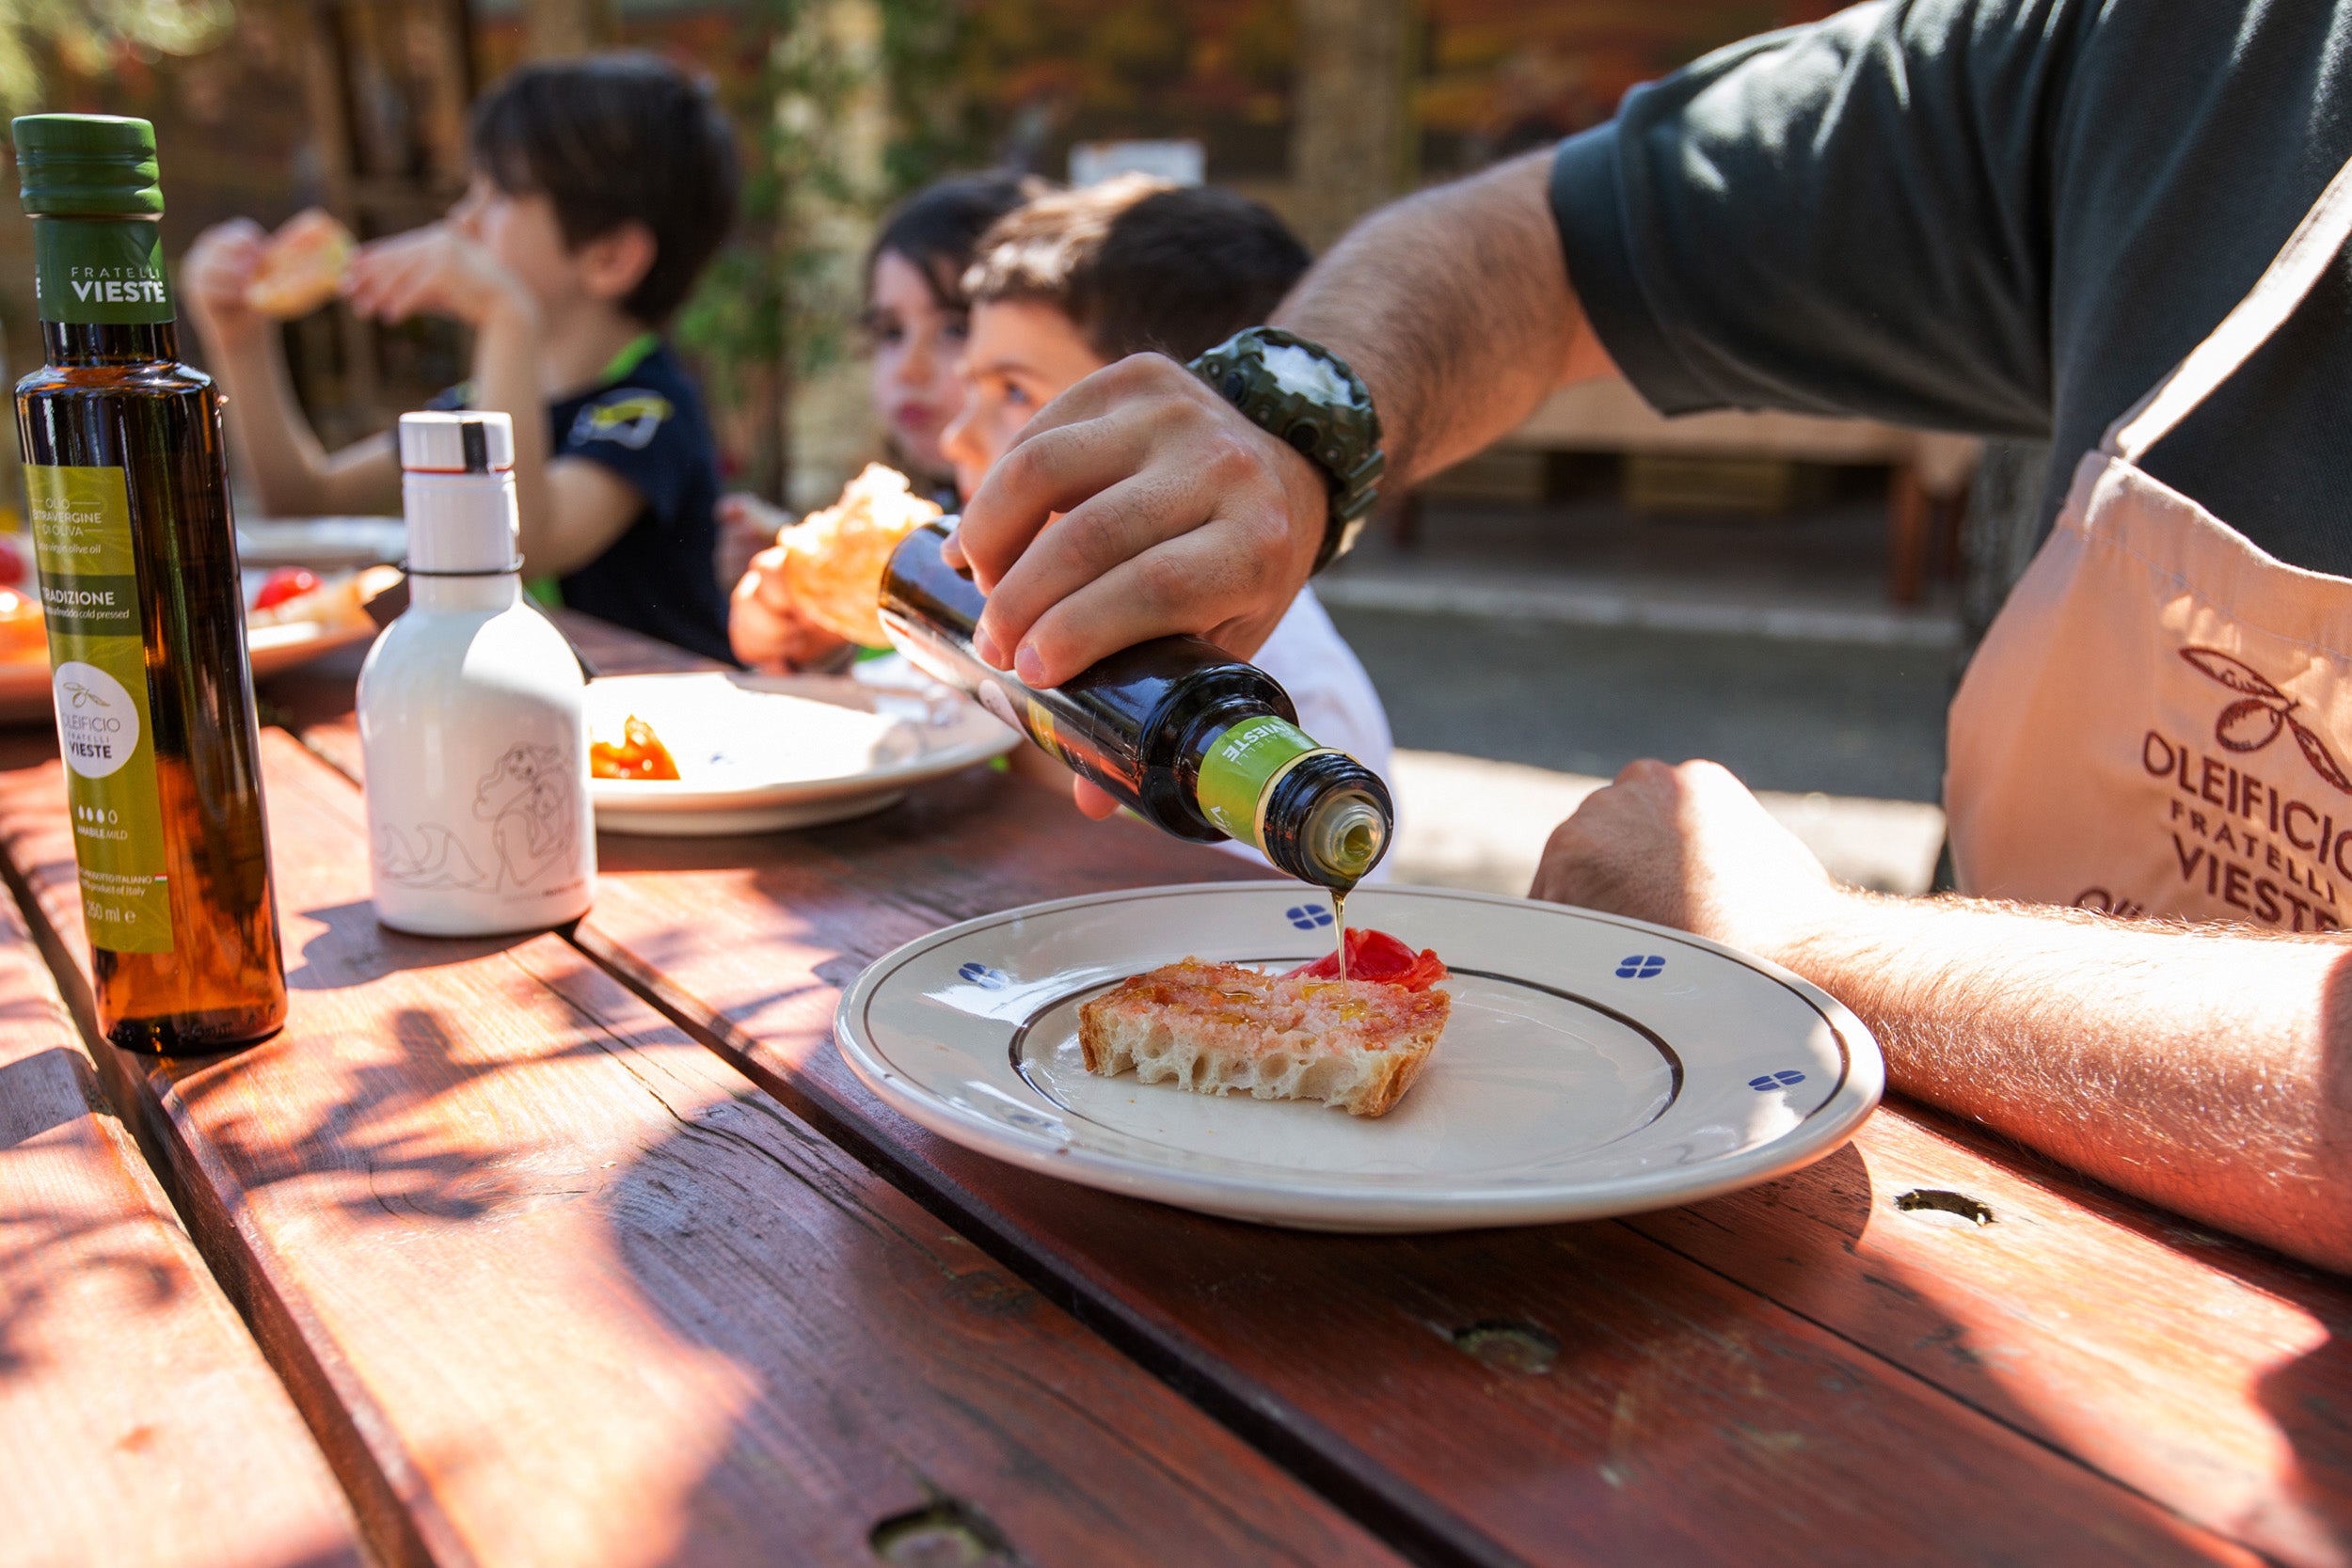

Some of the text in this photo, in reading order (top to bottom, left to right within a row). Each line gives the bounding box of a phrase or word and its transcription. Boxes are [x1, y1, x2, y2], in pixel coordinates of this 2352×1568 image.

[72, 266, 160, 278] FRATELLI
[71, 280, 166, 303] VIESTE
[45, 497, 71, 510] OLIO
[52, 524, 84, 537] OLIVA
[68, 544, 87, 555] olive
[88, 544, 102, 554] oil
[41, 586, 115, 606] TRADIZIONE
[79, 608, 96, 619] cold
[96, 609, 130, 621] pressed
[62, 712, 121, 734] OLEIFICIO
[69, 740, 112, 759] VIESTE
[1221, 722, 1287, 763] VIESTE
[105, 830, 128, 841] MILD
[2170, 799, 2337, 906] FRATELLI
[104, 907, 120, 923] ml
